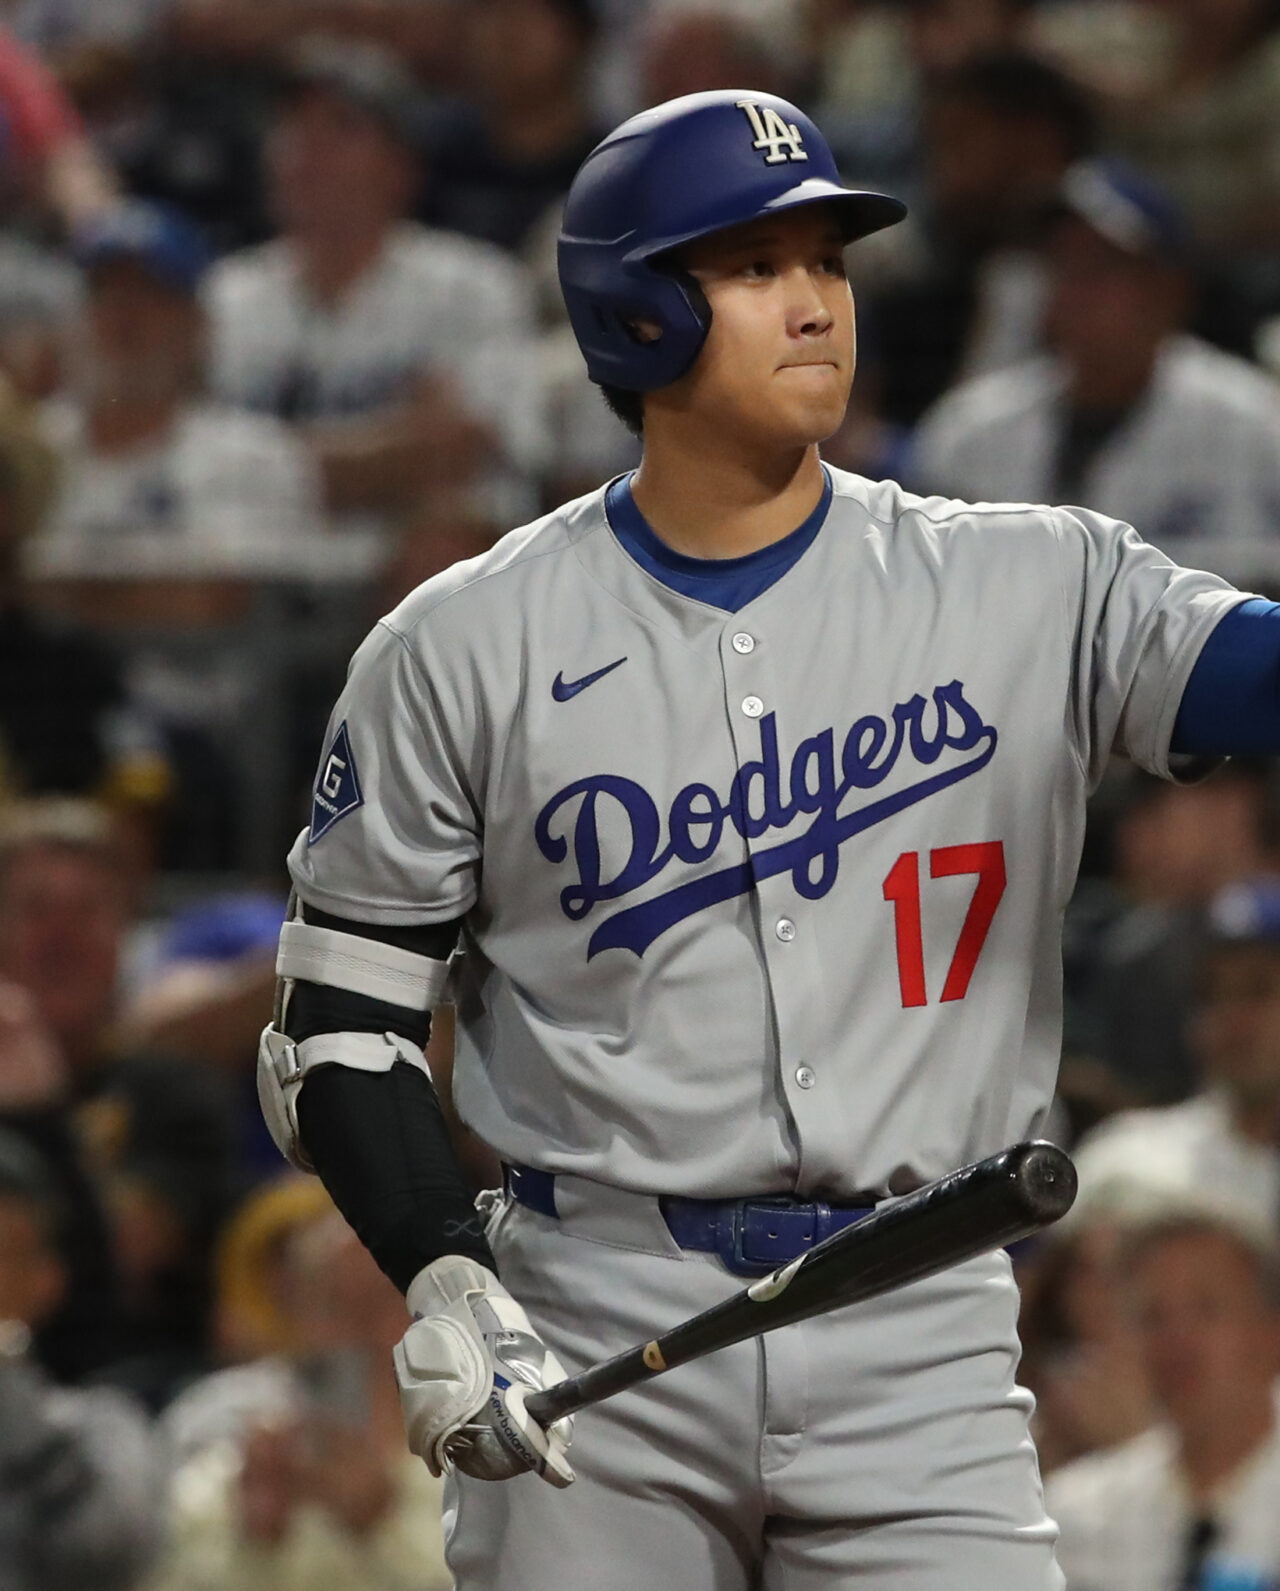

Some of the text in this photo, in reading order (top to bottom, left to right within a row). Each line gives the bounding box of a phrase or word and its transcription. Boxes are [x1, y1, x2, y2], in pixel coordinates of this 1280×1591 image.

[735, 99, 808, 165] LA
[322, 753, 347, 799] G
[534, 679, 992, 921] Dodgers
[882, 840, 1007, 1008] 17
[500, 1417, 538, 1467] balance
